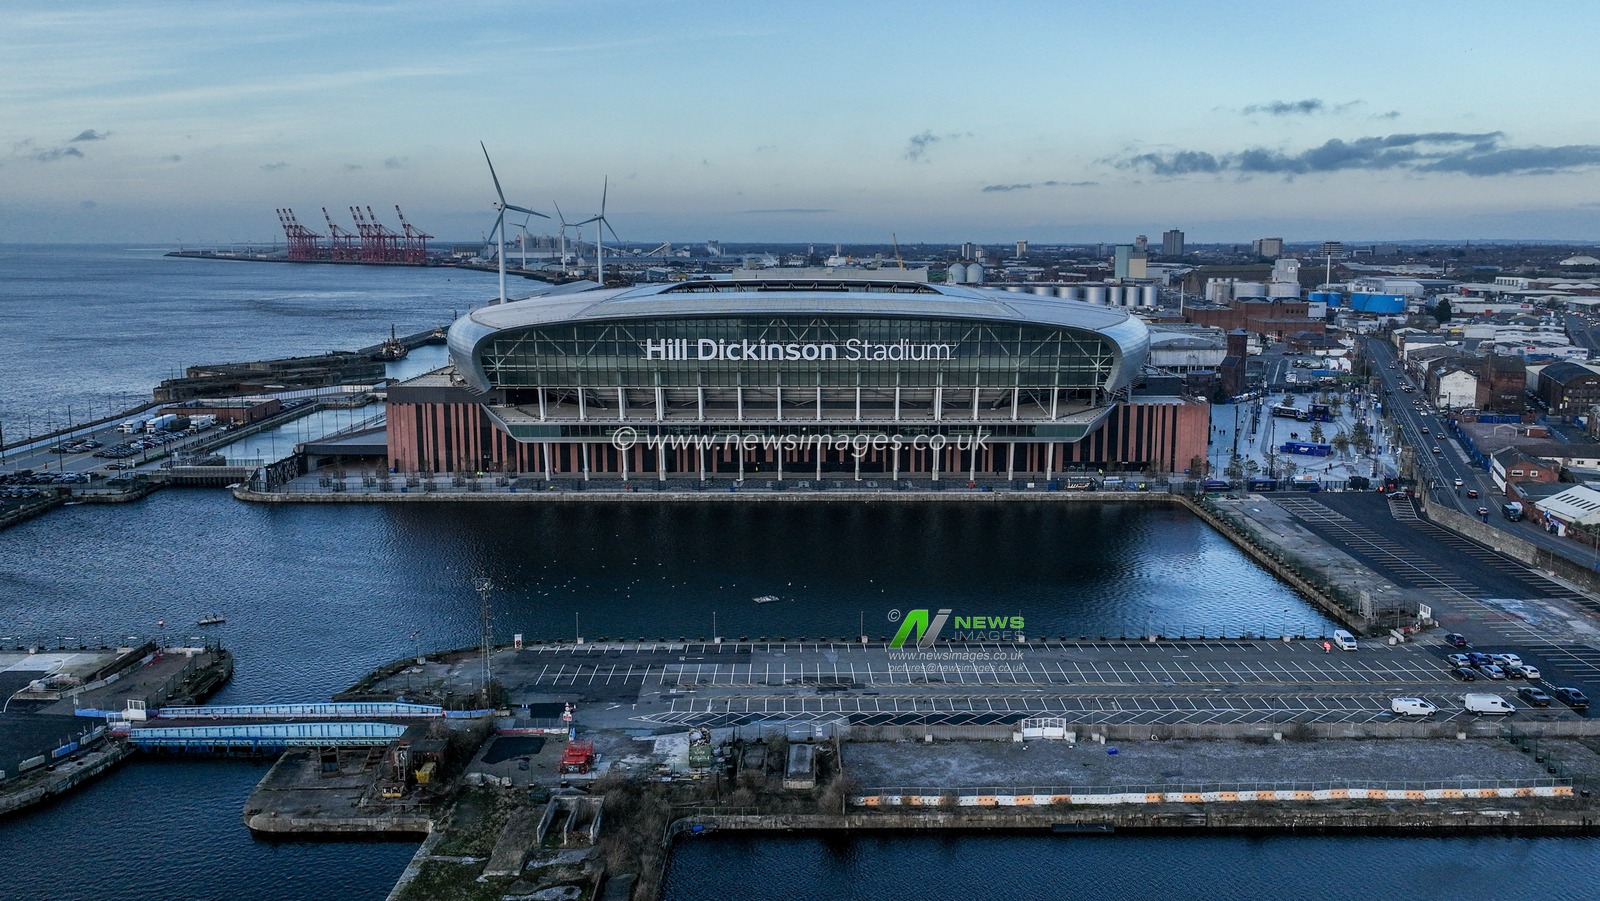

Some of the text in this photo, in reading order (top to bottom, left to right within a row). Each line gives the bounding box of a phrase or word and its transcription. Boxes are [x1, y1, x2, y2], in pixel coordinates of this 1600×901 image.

[646, 338, 951, 361] Hill Dickinson Stadium
